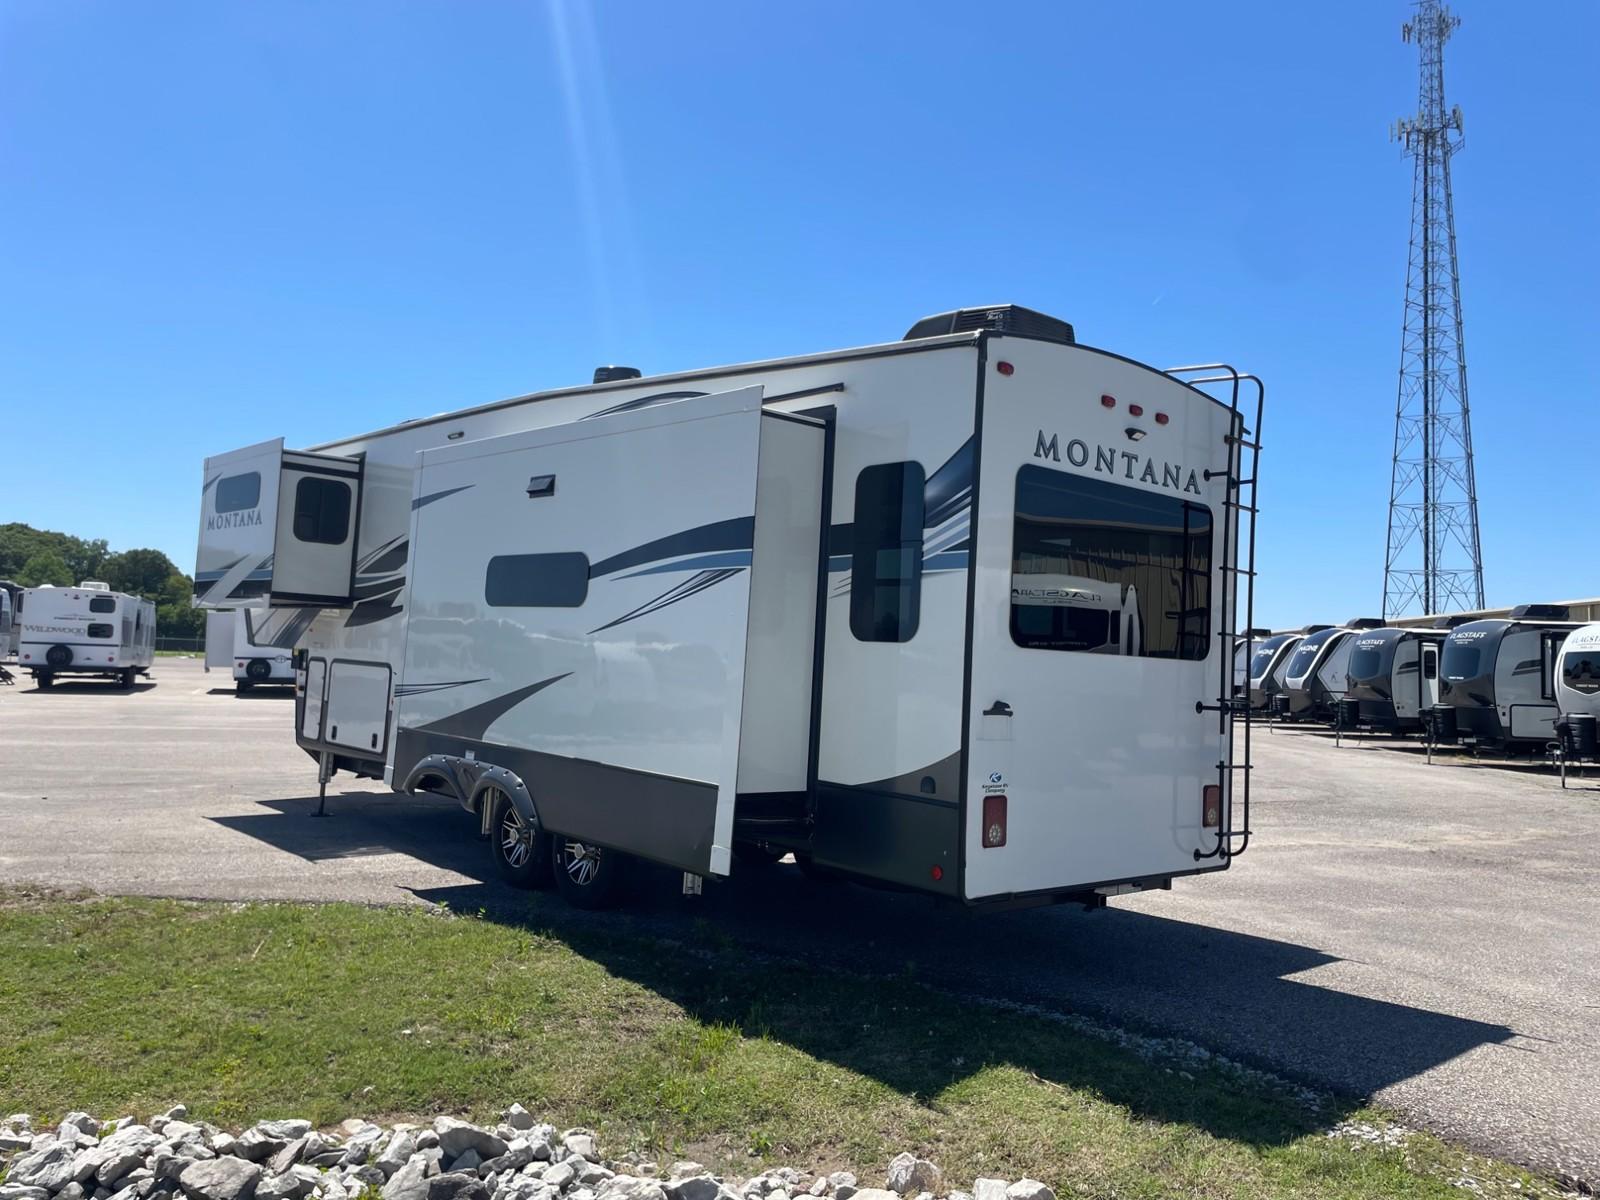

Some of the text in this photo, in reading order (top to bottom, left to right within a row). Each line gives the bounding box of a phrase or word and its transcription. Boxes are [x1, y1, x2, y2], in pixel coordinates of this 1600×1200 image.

[1033, 429, 1202, 495] MONTANA
[207, 510, 263, 530] MONTANA
[24, 624, 87, 635] WILDWOOD
[1449, 631, 1488, 640] FLAGSTAFF
[1571, 635, 1600, 644] FLAGST
